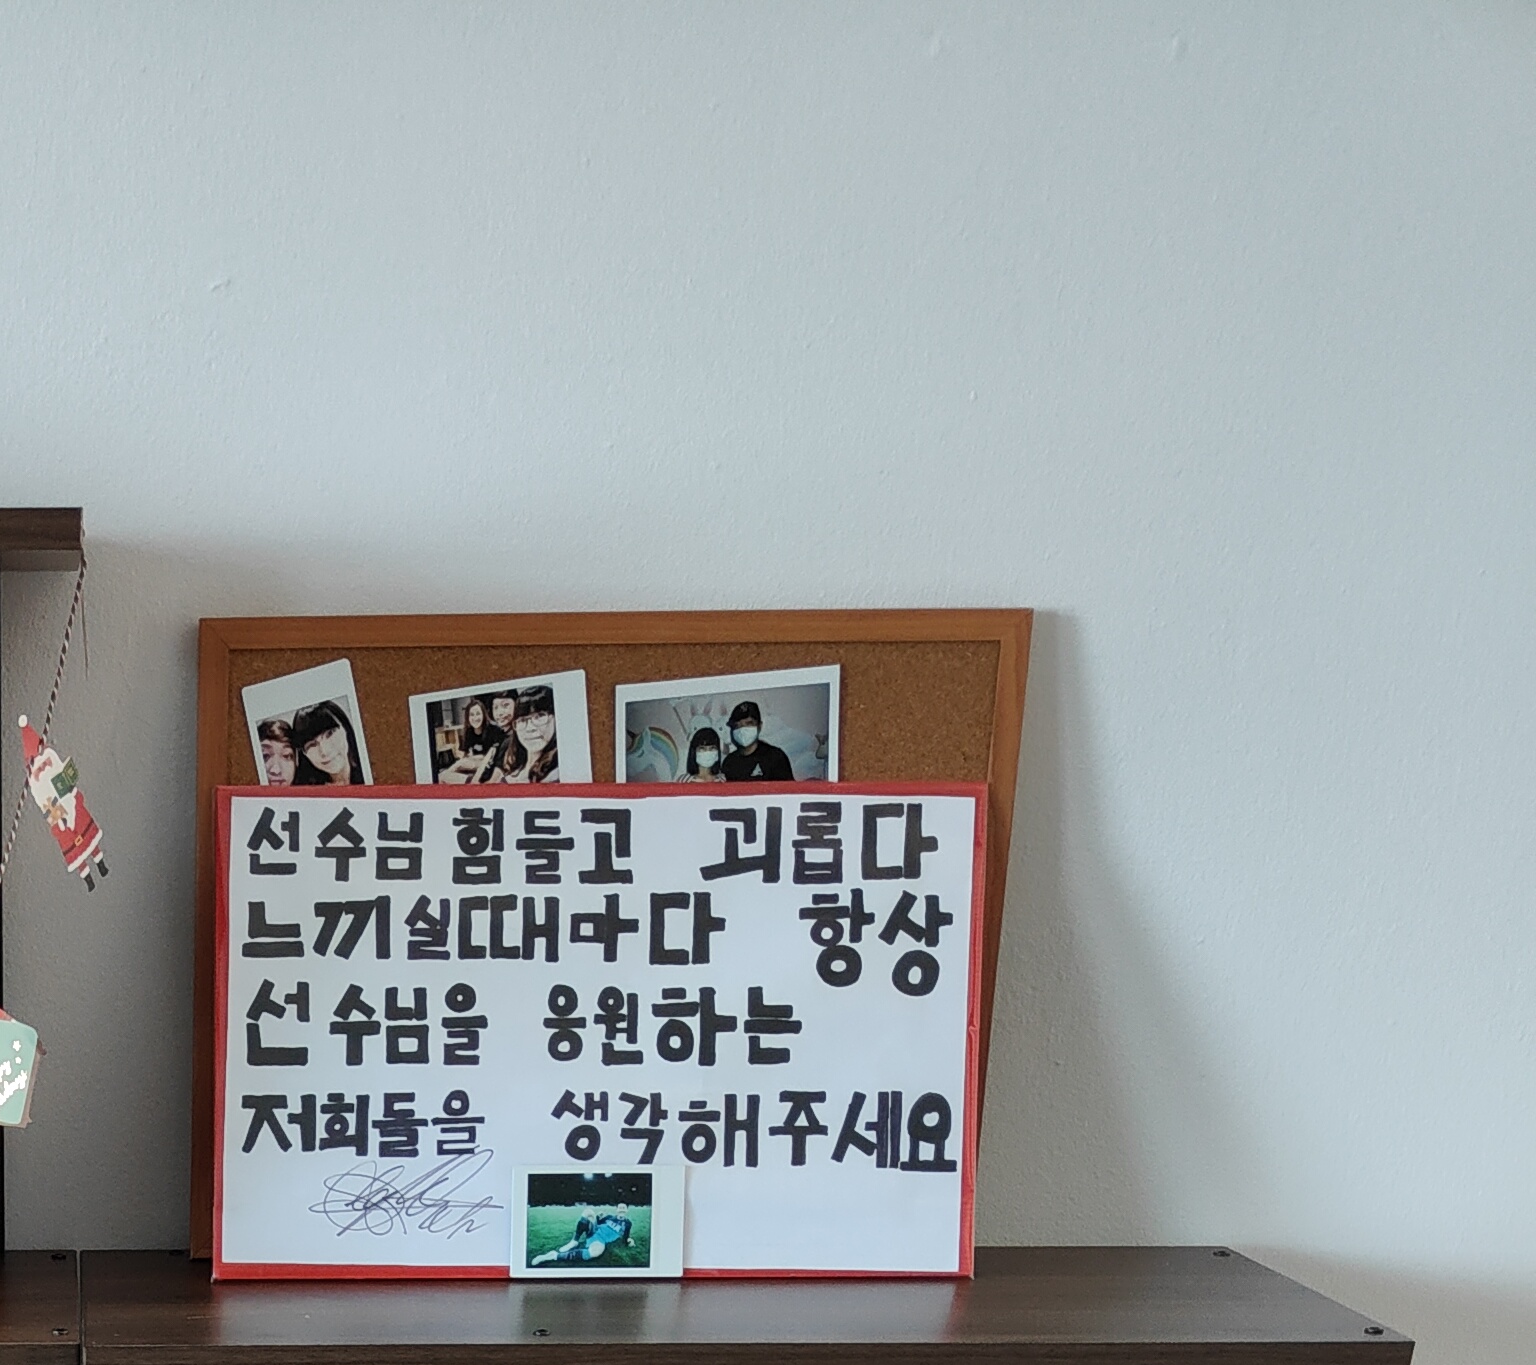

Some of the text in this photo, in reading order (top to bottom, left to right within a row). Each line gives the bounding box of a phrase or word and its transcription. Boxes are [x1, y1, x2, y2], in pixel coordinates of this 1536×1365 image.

[247, 802, 939, 885] 선수님 힘들고 괴롭다
[799, 888, 954, 997] 항상
[246, 979, 803, 1067] 선수님을 응원하는
[551, 1090, 957, 1172] 생각해주세요
